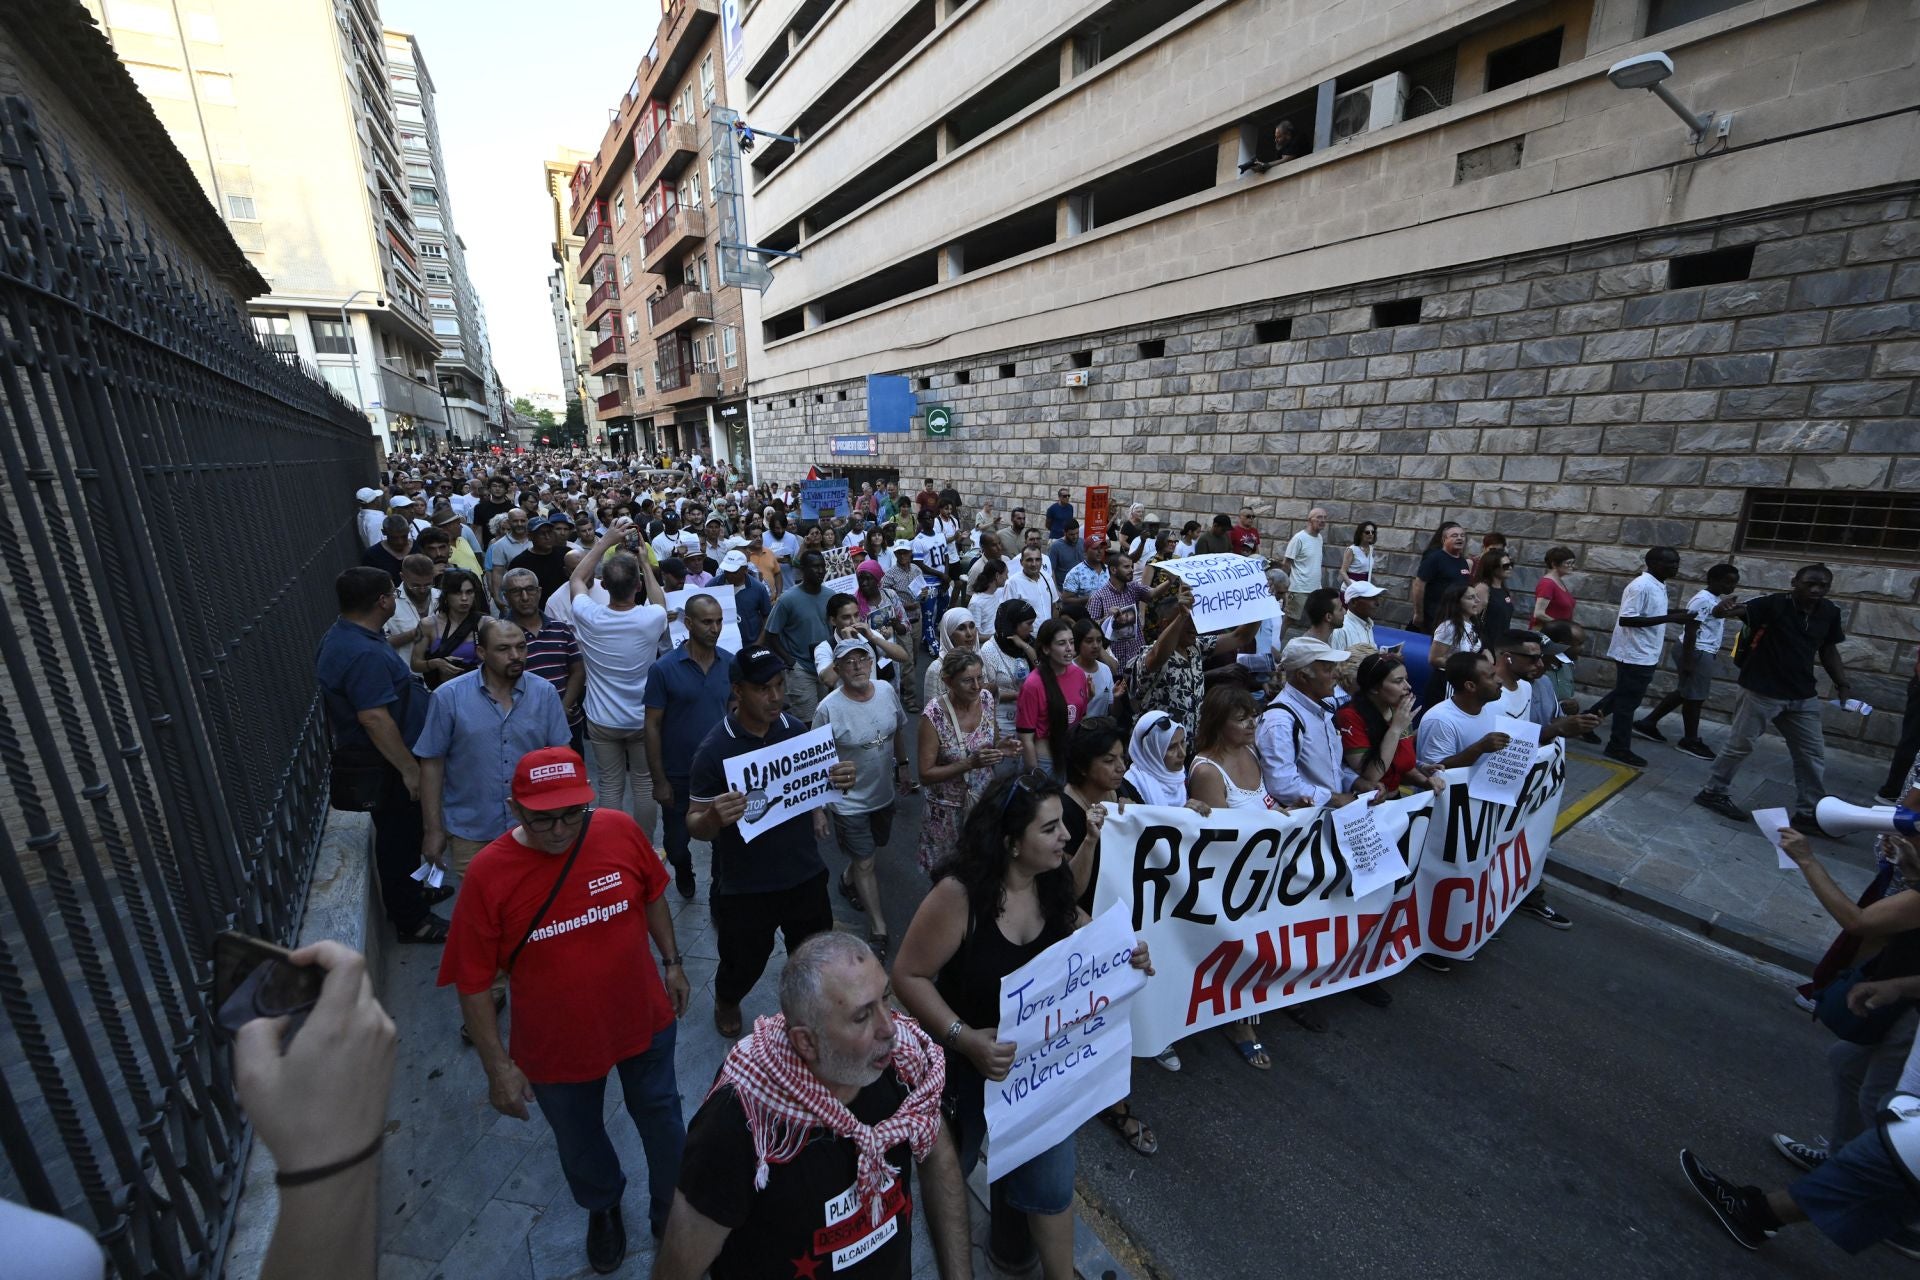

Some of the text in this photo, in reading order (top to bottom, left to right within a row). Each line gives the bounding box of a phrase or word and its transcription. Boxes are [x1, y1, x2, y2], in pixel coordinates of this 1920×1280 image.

[1185, 559, 1266, 588] SENTIMIENTO
[792, 739, 835, 764] SOBRAN
[532, 765, 564, 777] CCOO
[769, 756, 792, 781] NO
[783, 768, 829, 795] SOBRA
[1489, 776, 1508, 785] COLOR
[588, 871, 621, 890] CCOO
[527, 899, 629, 943] ensionesDignas
[1007, 949, 1132, 1026] Torre Pacheco
[837, 1224, 895, 1264] ALCANTARILLA
